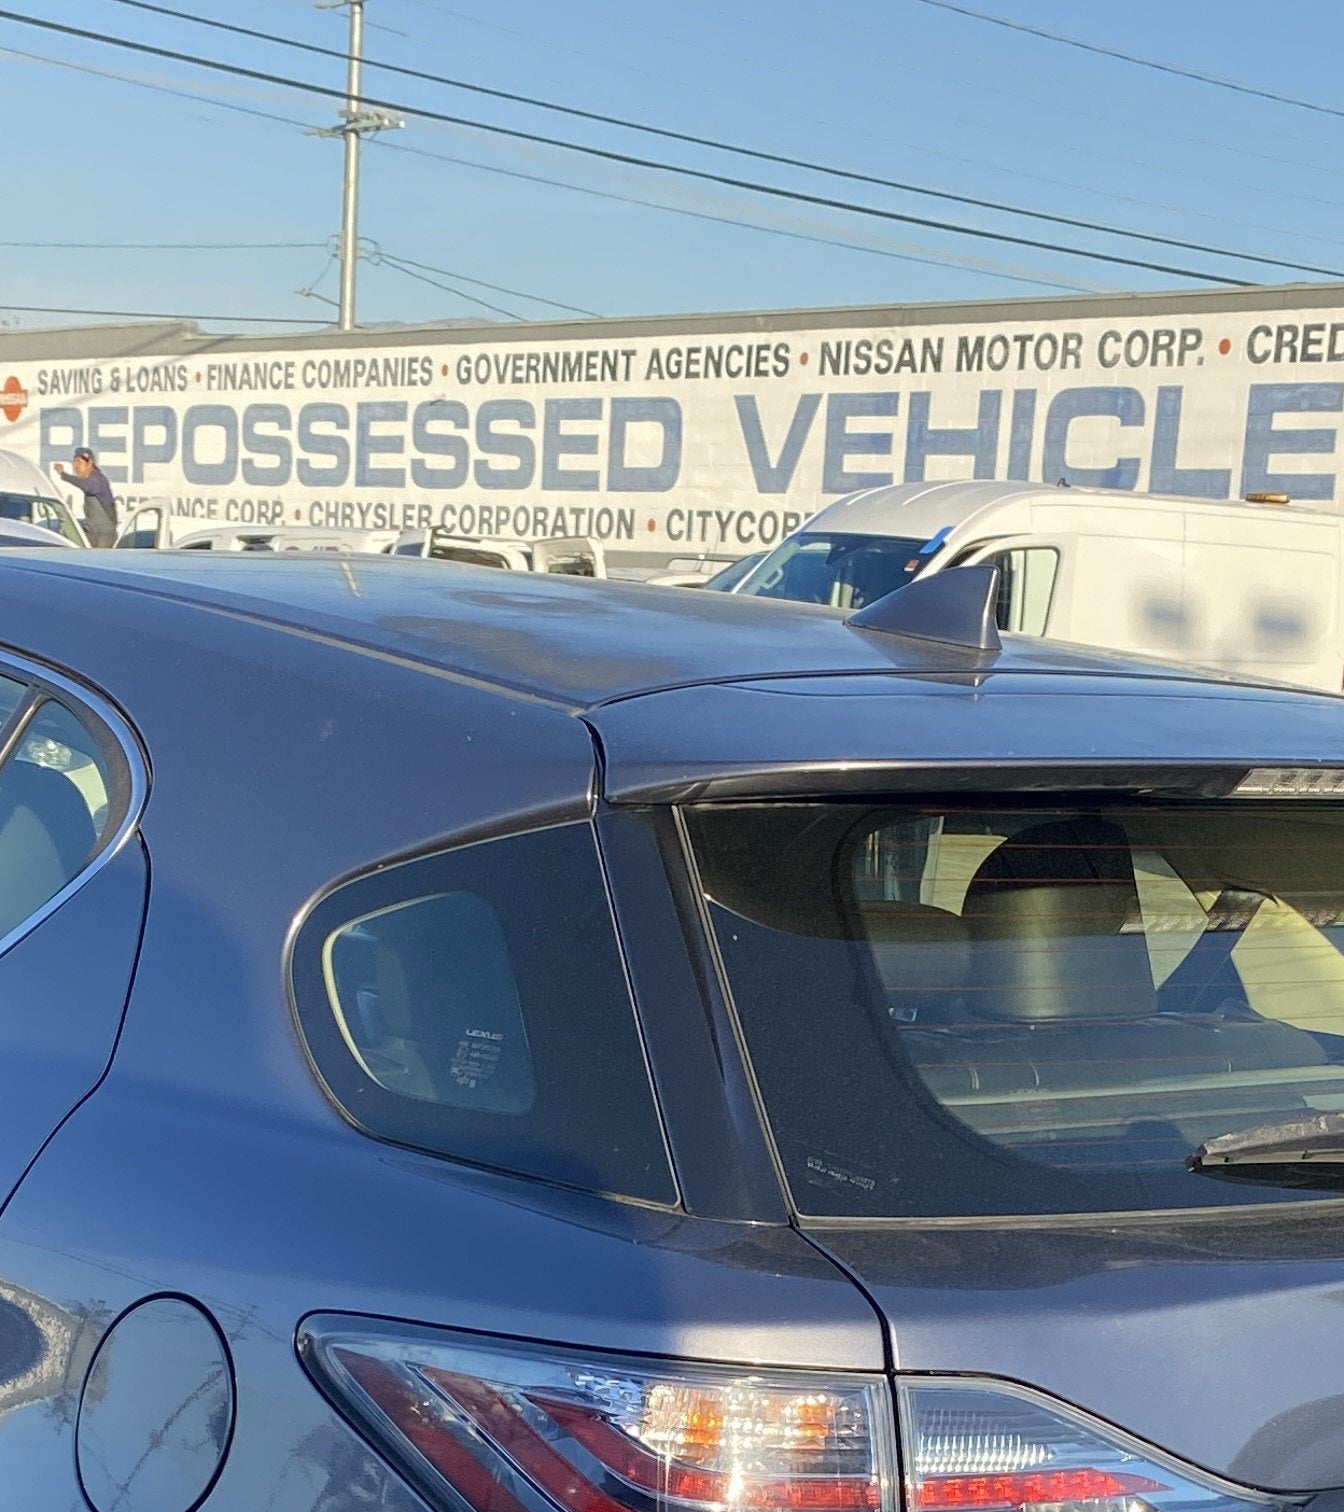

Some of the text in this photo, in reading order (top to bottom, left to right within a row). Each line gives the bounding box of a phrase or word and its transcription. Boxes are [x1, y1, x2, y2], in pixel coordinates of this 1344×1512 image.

[37, 366, 103, 396] SAVING
[110, 367, 121, 393] &
[126, 364, 188, 393] LOANS
[206, 358, 297, 393] FINANCE
[301, 355, 433, 390] COMPANIES
[456, 349, 637, 387] GOVERNMENT
[645, 343, 791, 381] AGENCIES
[818, 336, 945, 377] NISSAN
[955, 331, 1083, 372] MOTOR
[1098, 327, 1205, 369] CORP.
[40, 397, 683, 493] REPOSSESSED
[226, 497, 286, 527] CORP.
[308, 504, 432, 532] CHRYSLER
[441, 505, 637, 542] CORPORATION
[466, 1028, 504, 1040] LEXUS
